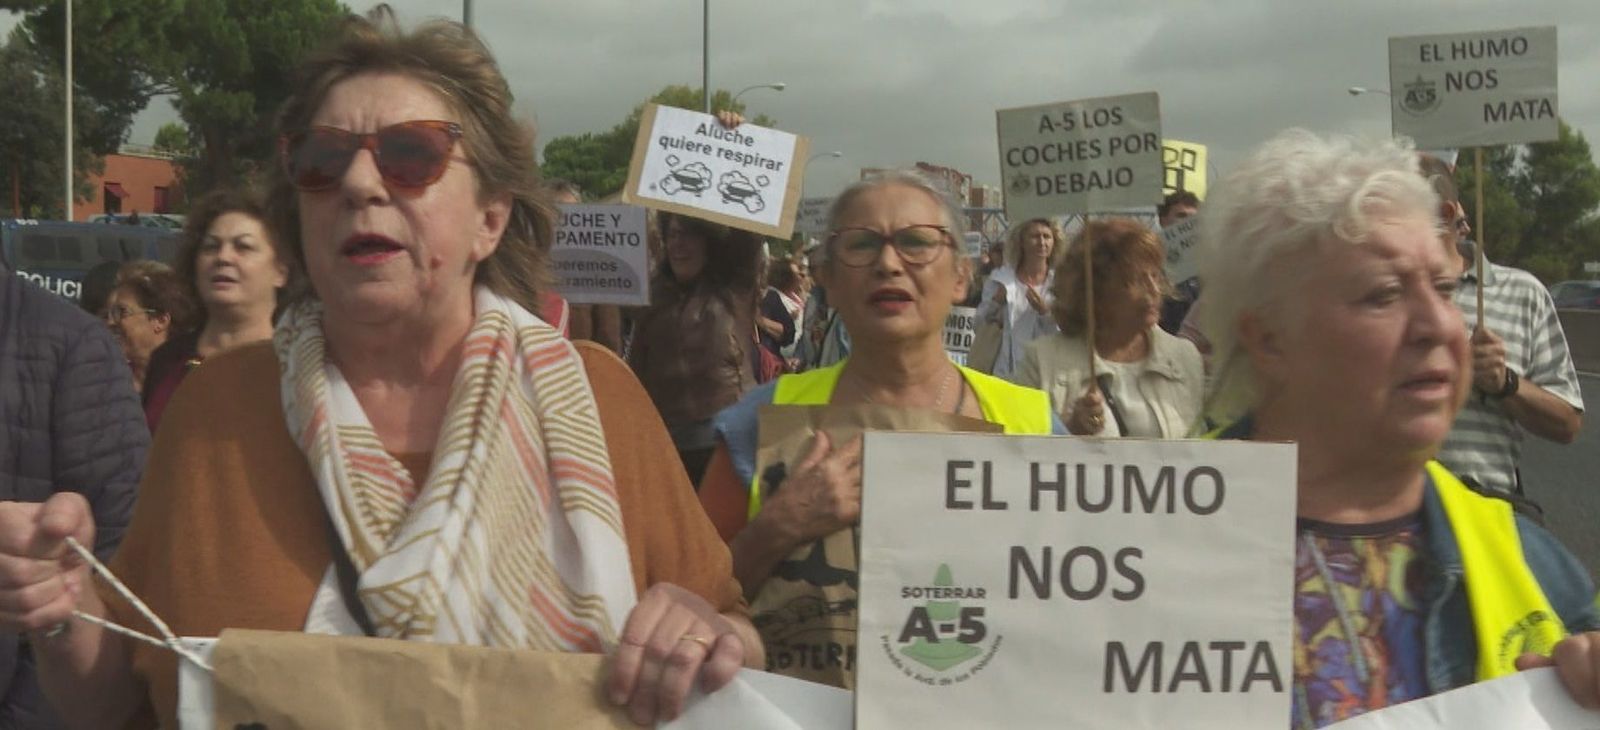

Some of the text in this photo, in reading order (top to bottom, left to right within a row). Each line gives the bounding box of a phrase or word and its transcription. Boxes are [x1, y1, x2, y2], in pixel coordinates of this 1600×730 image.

[1420, 36, 1528, 62] EL HUMO
[1445, 69, 1498, 92] NOS
[1038, 107, 1123, 134] A-5 LOS
[1483, 98, 1554, 123] MATA
[696, 123, 755, 147] Aluche
[659, 135, 784, 172] quiere respirar
[1006, 132, 1158, 167] COCHES POR
[1036, 167, 1134, 196] DEBAJO
[562, 213, 621, 228] UCHE Y
[556, 231, 640, 246] PAMENTO
[553, 260, 618, 272] ueremos
[16, 270, 82, 299] OLICI
[565, 276, 632, 289] ramiento
[945, 312, 973, 330] MOS
[945, 331, 972, 348] IDO
[945, 460, 1226, 515] EL HUMO
[1008, 545, 1145, 601] NOS
[901, 586, 986, 599] SOTERRAR
[897, 607, 987, 644] A-5
[1103, 641, 1284, 693] MATA
